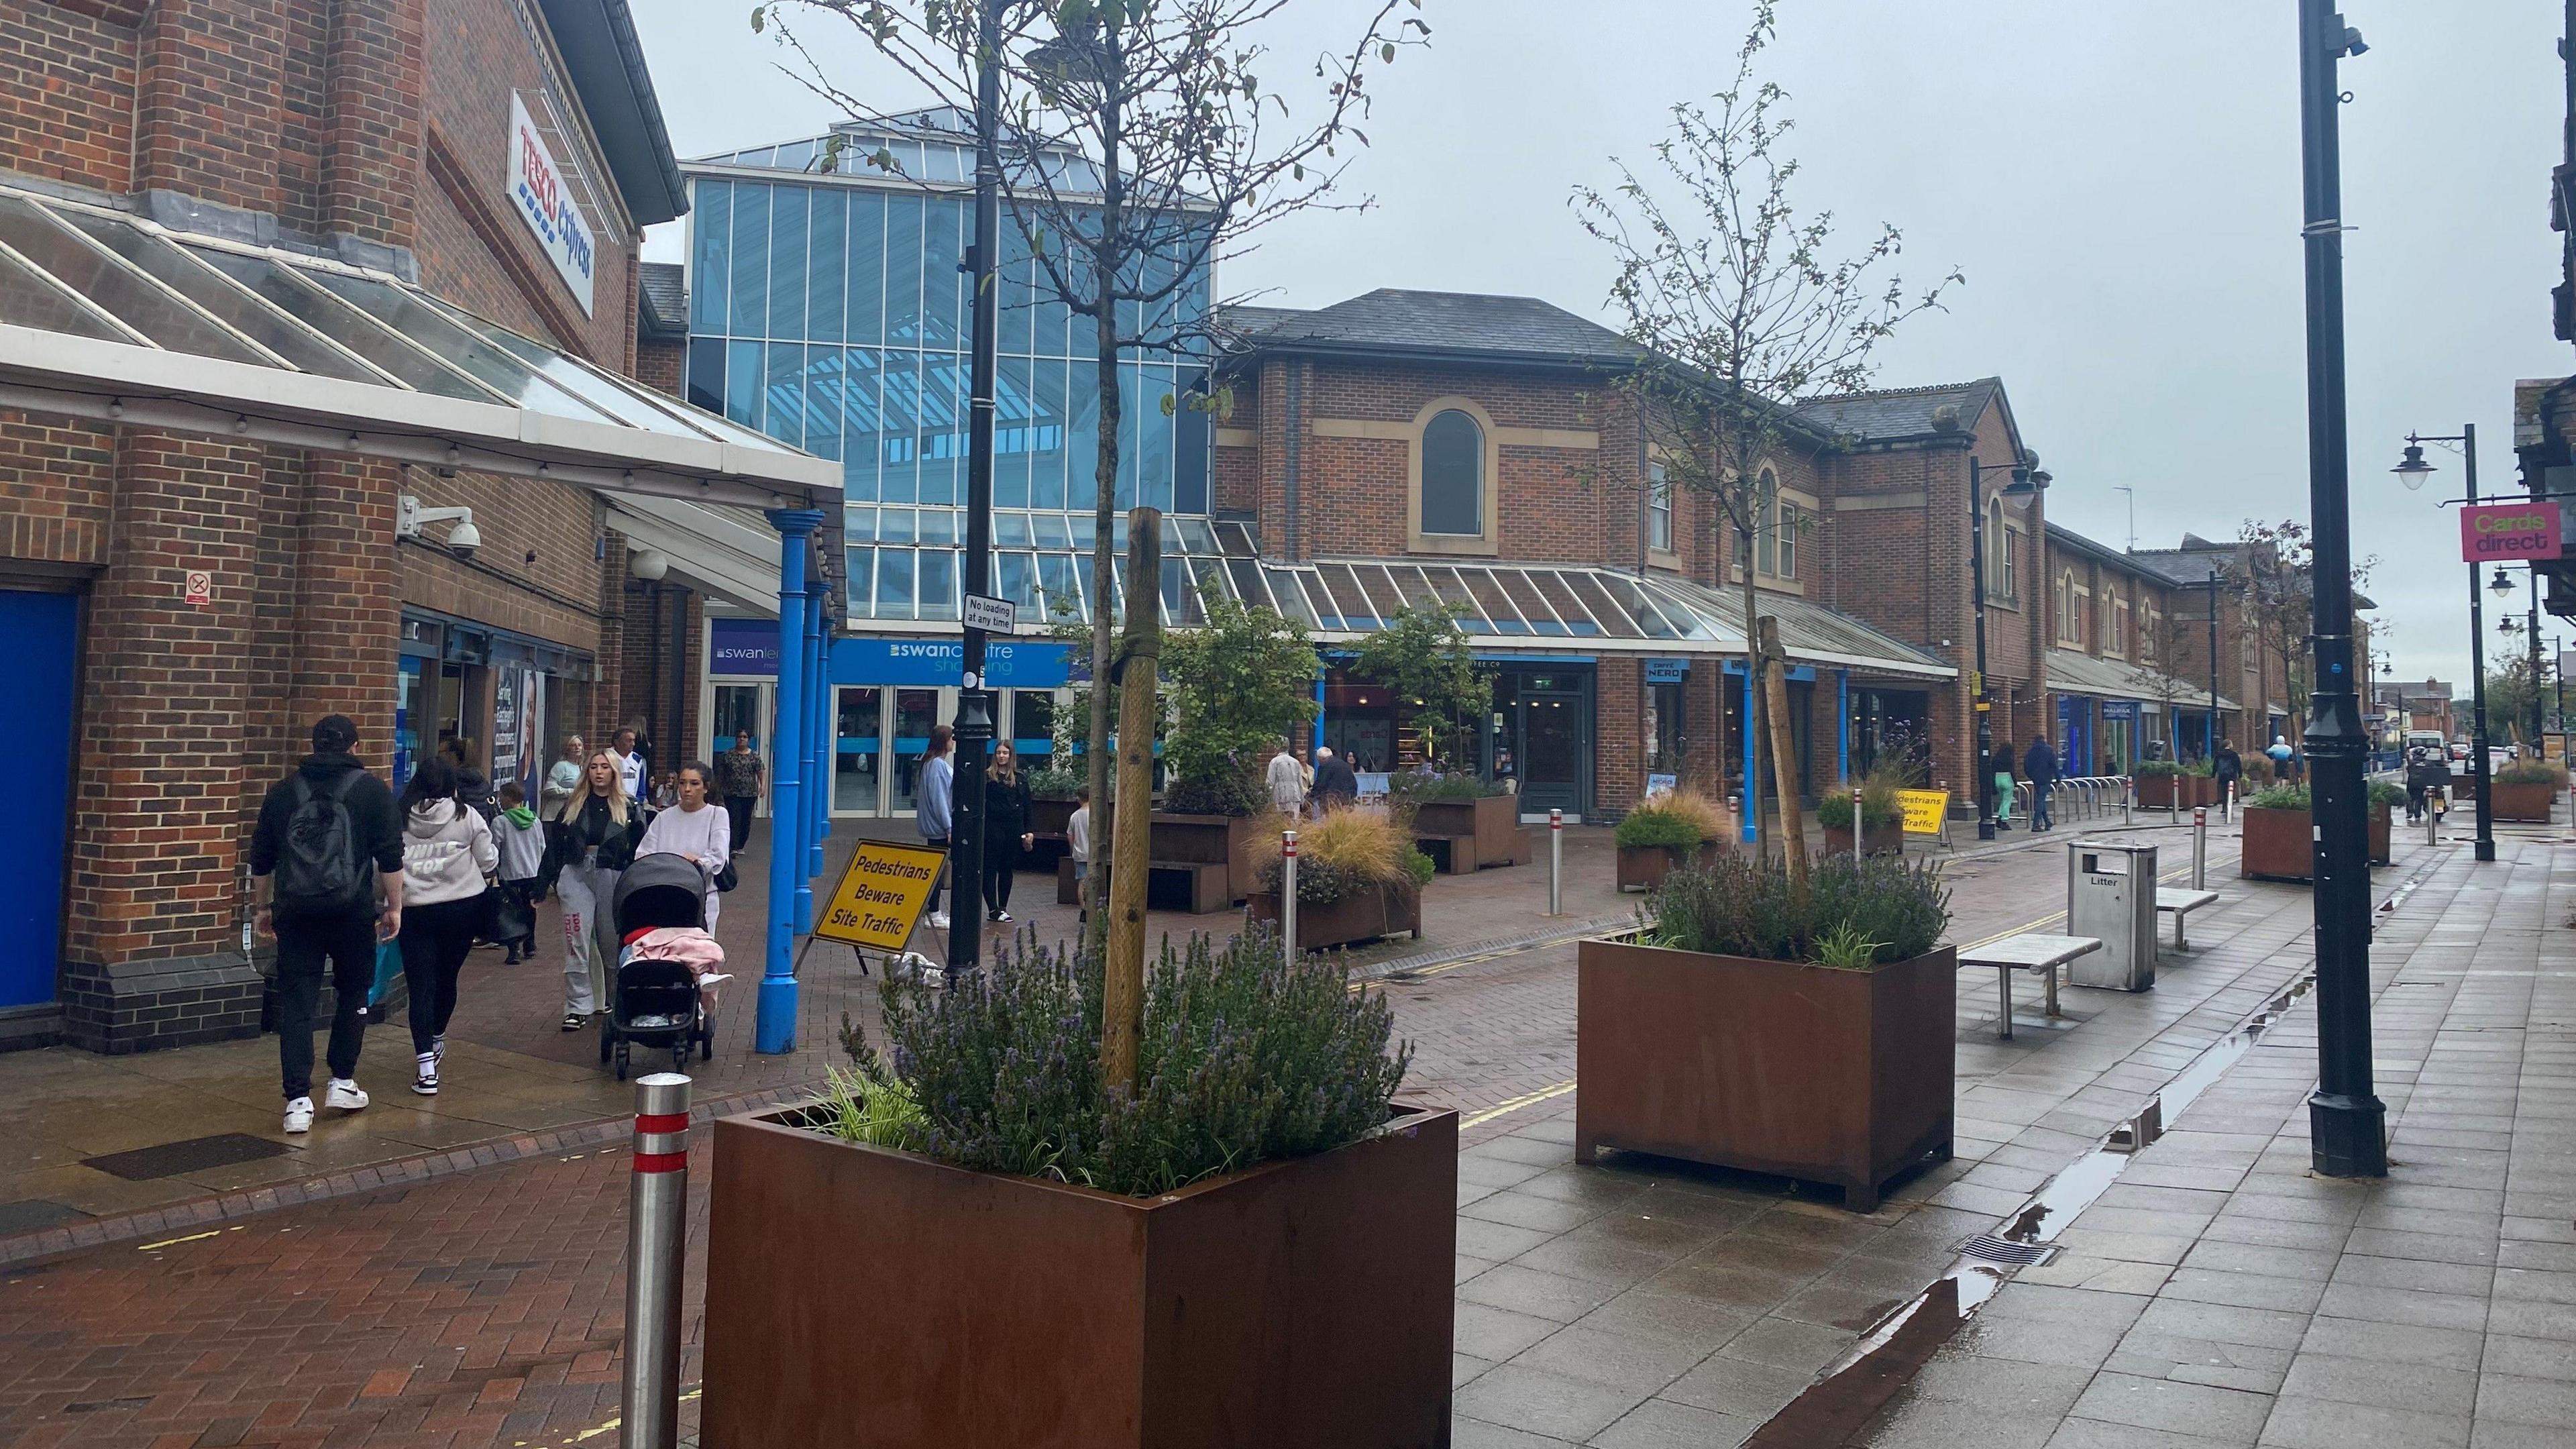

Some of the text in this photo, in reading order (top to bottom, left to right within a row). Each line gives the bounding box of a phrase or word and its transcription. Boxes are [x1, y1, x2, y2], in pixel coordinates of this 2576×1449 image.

[521, 125, 591, 279] TESCO express
[2475, 512, 2546, 533] Cards
[2476, 533, 2548, 553] direct
[970, 599, 1010, 617] No loading
[968, 612, 1009, 628] at any time
[935, 657, 1012, 676] shoing
[1649, 669, 1679, 677] NERO
[498, 683, 511, 705] Serving
[1898, 795, 1941, 805] destrians
[1904, 818, 1934, 828] Traffic
[402, 841, 464, 859] WHITE
[412, 857, 448, 875] FOX
[854, 855, 931, 881] Pedestrians
[2091, 877, 2118, 886] Litter
[855, 883, 905, 906] Beware
[572, 912, 580, 932] TOO
[830, 908, 904, 935] Site Traffic
